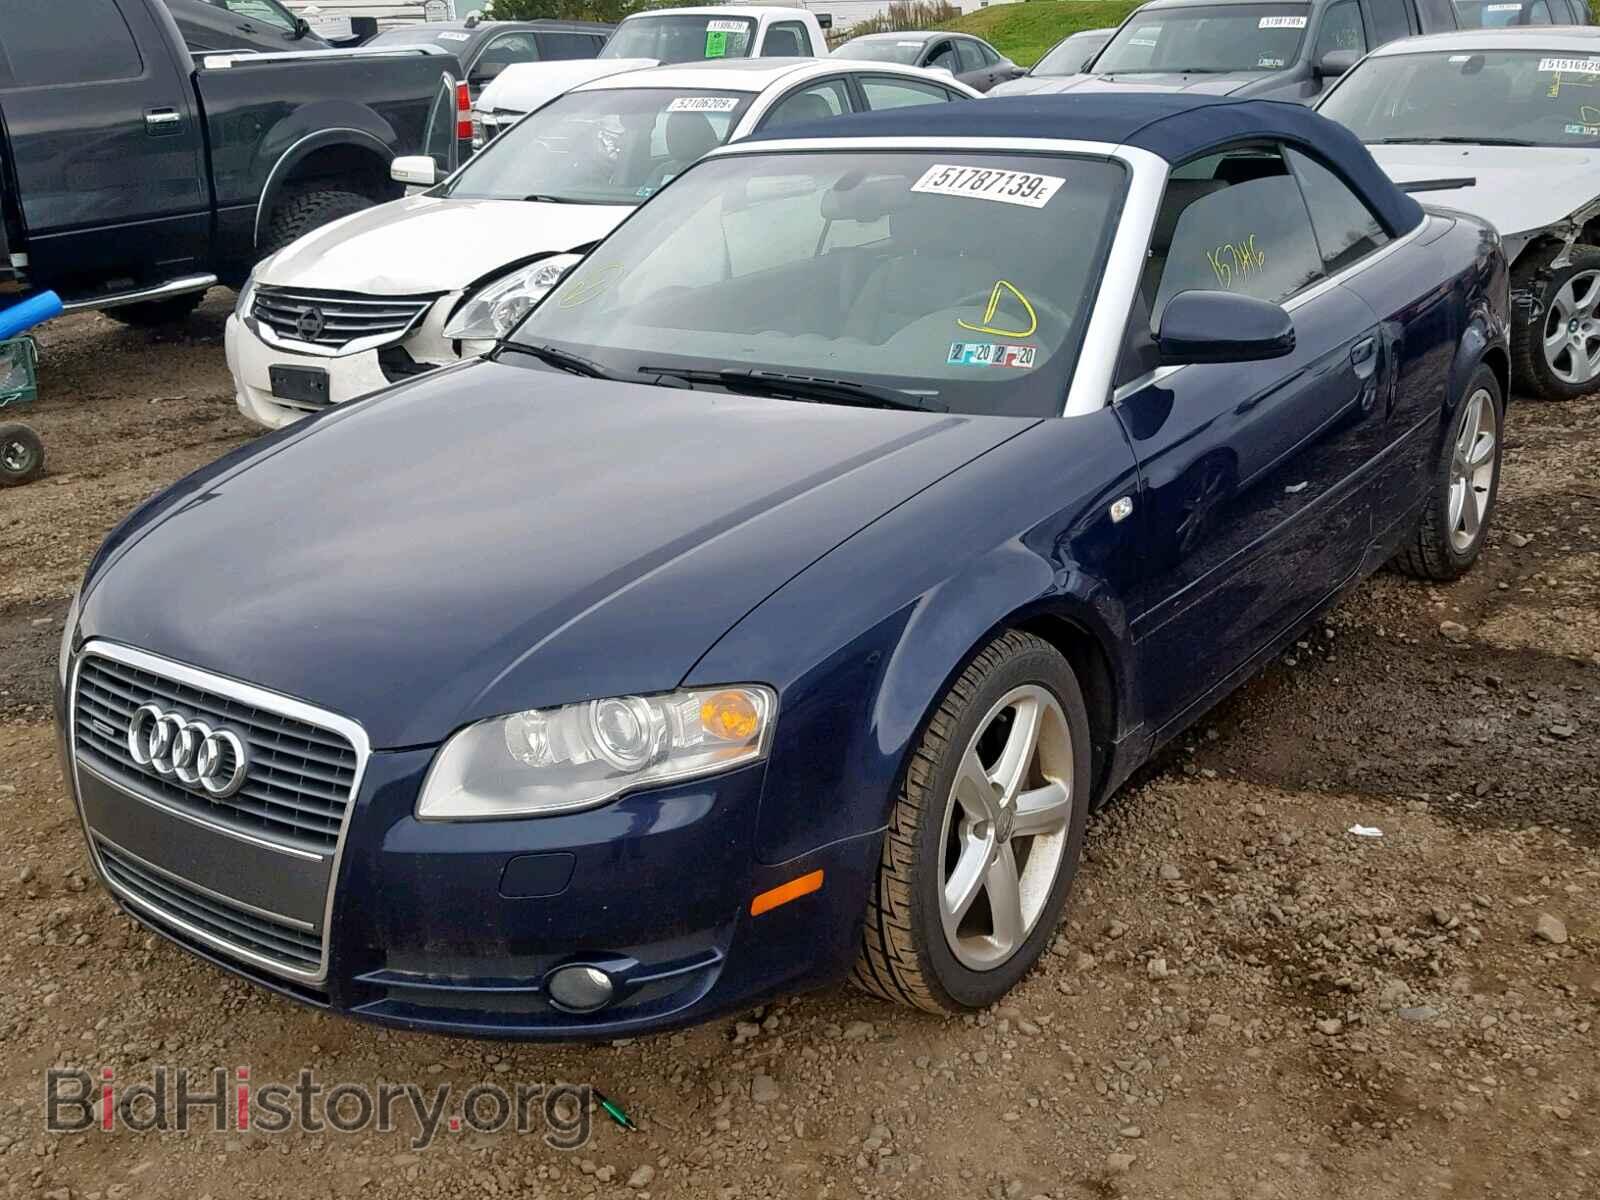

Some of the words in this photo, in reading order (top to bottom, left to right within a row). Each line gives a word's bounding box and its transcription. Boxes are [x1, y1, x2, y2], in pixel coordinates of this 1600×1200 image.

[952, 343, 963, 360] 2
[977, 345, 991, 361] 20
[996, 346, 1006, 363] 2
[1020, 348, 1034, 364] 20
